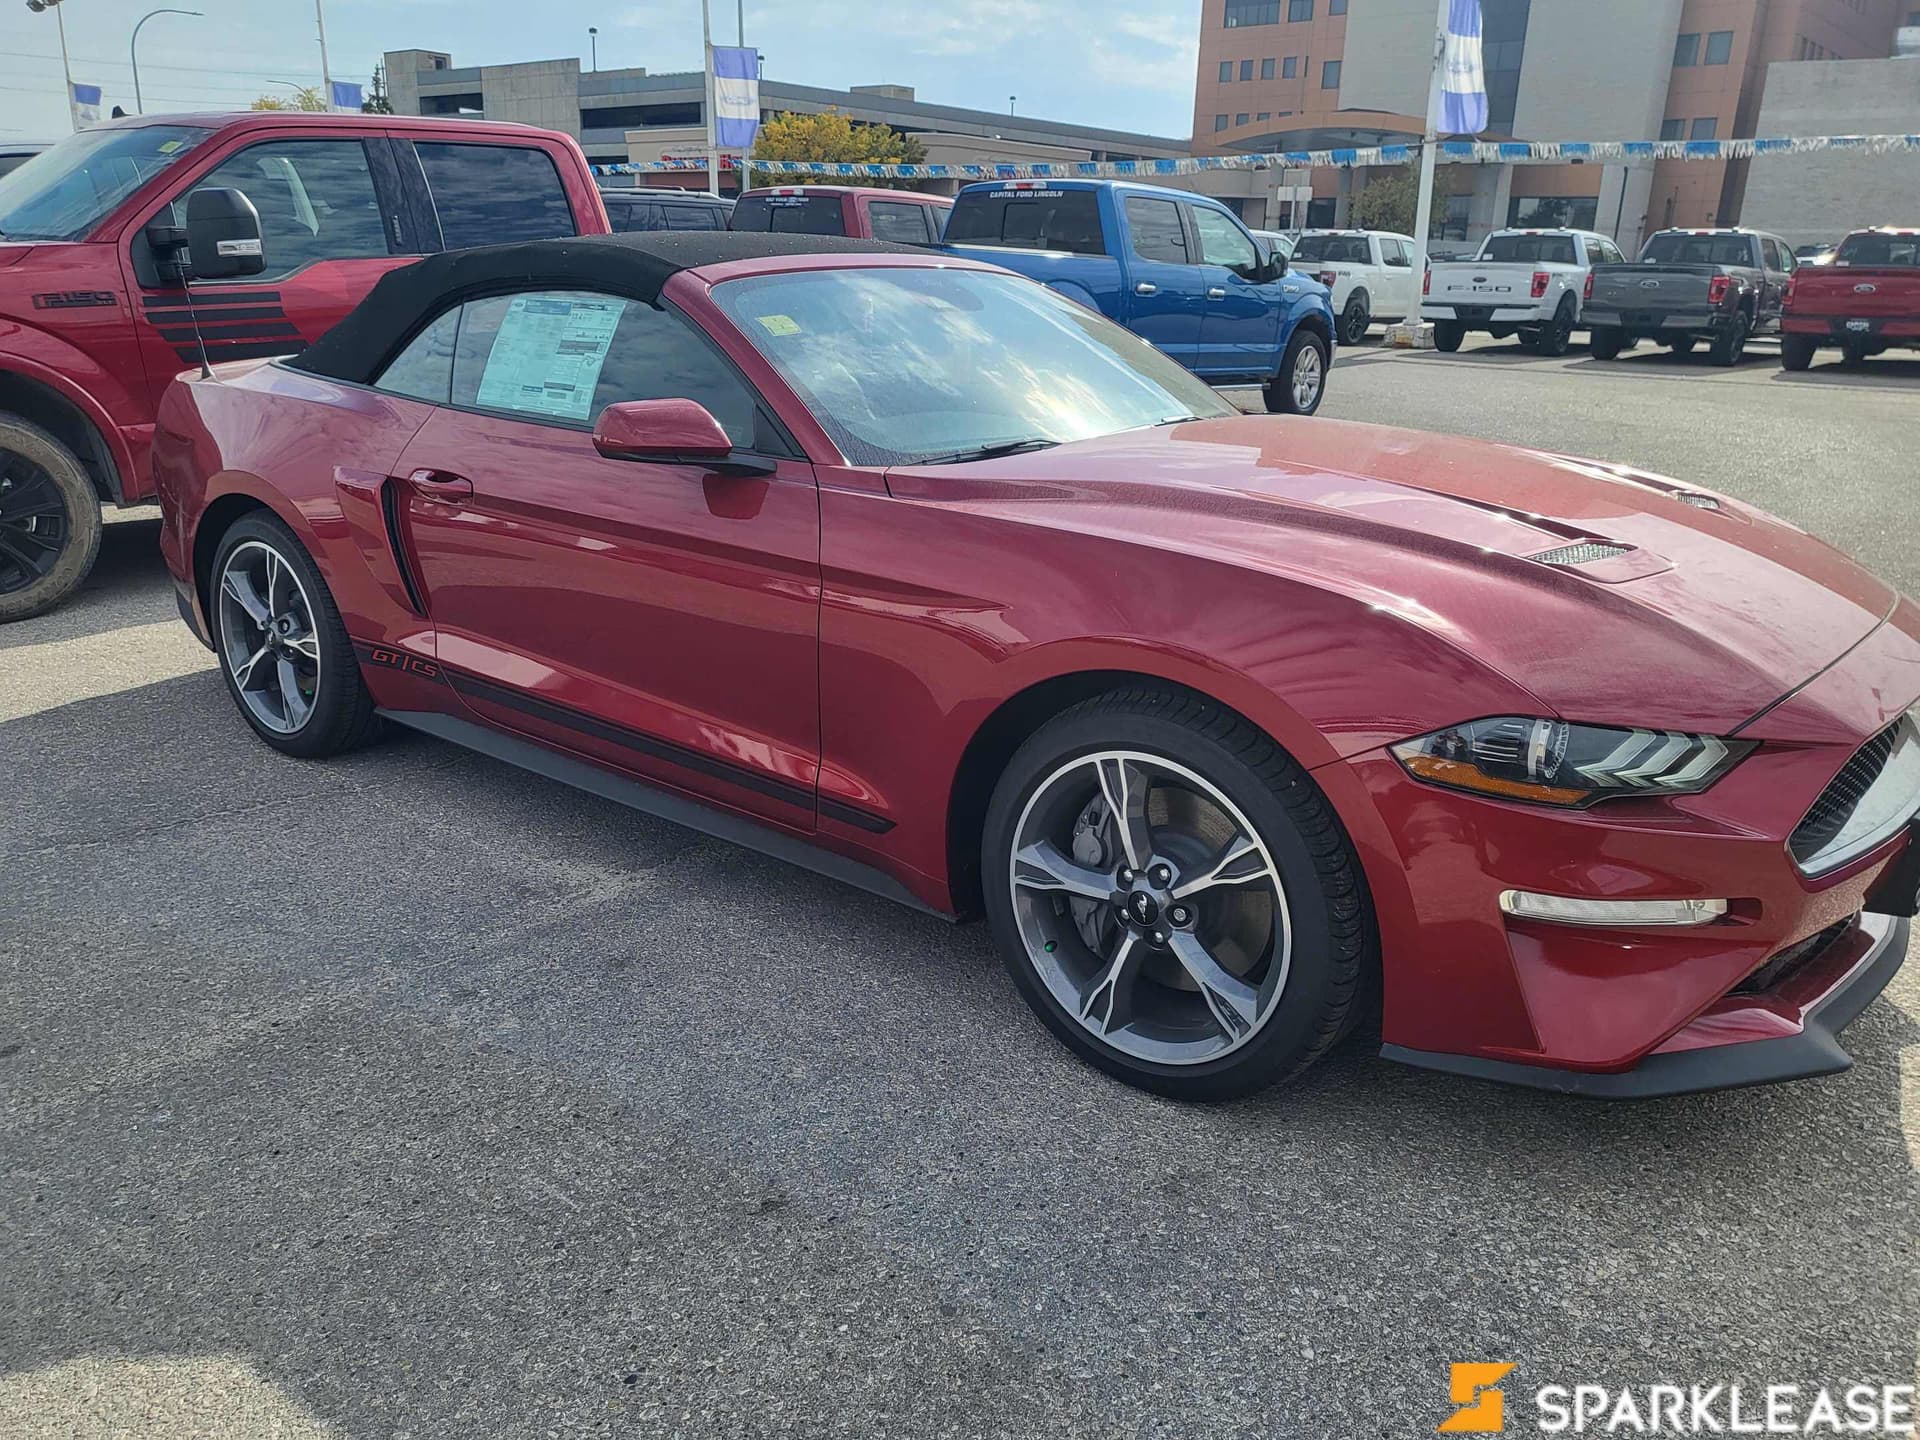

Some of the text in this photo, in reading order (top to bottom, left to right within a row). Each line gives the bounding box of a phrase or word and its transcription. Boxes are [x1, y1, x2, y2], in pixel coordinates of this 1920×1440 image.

[990, 190, 1064, 199] CAPITAL FORD LINCOLN
